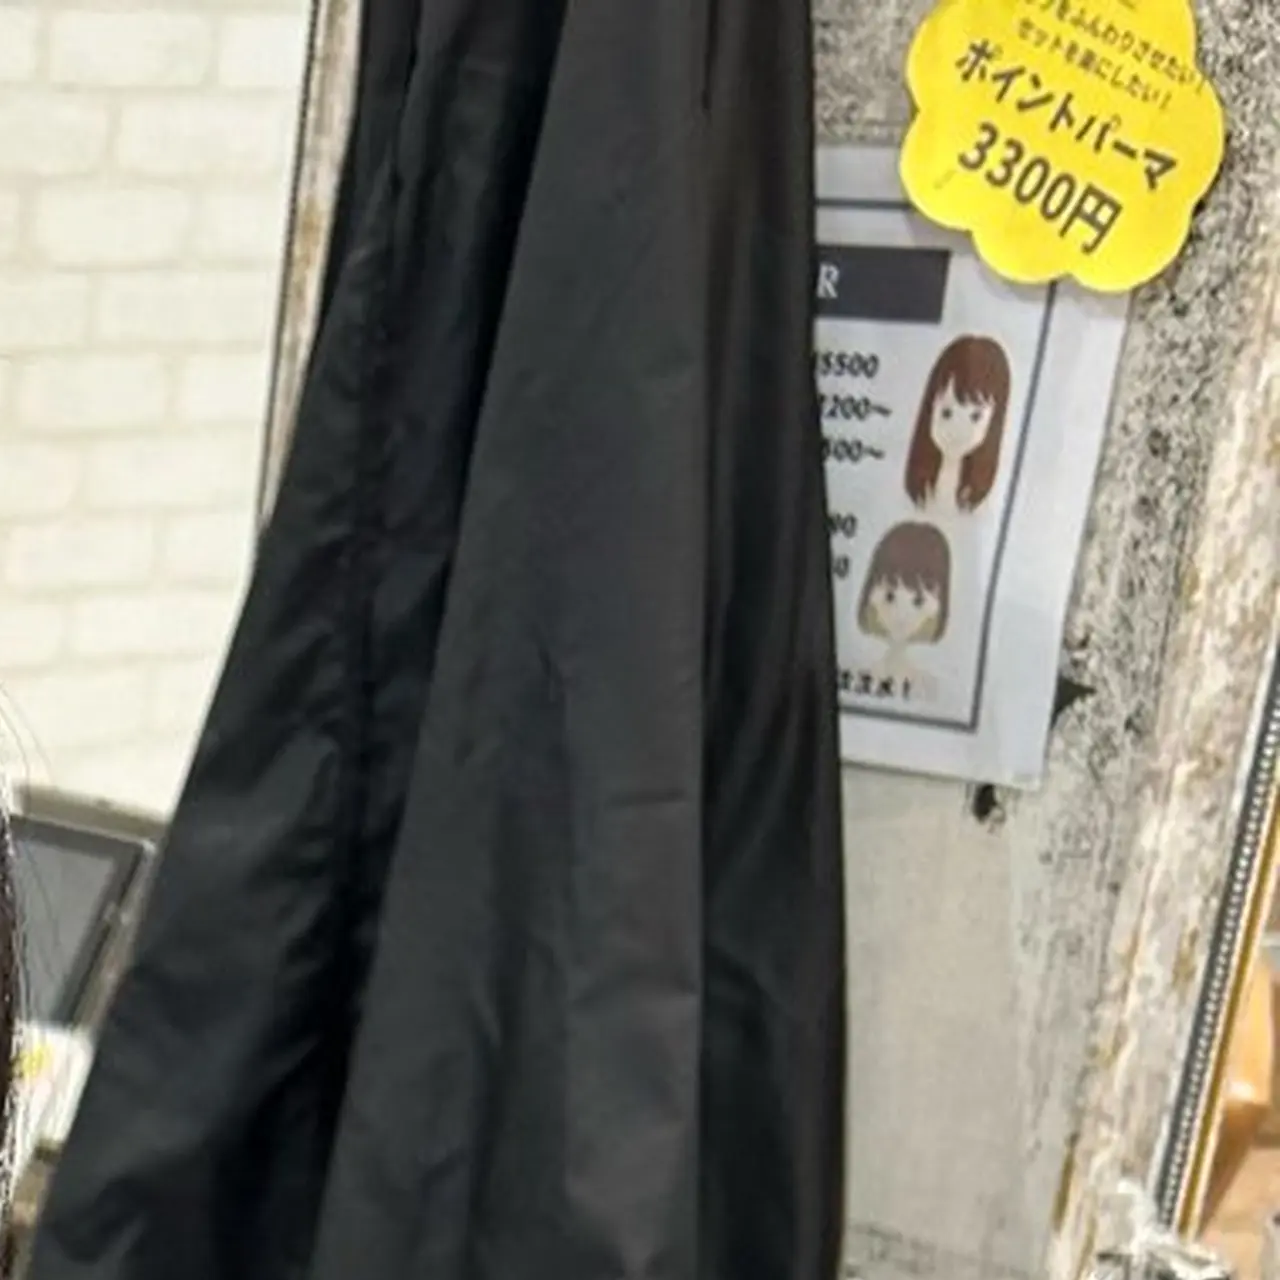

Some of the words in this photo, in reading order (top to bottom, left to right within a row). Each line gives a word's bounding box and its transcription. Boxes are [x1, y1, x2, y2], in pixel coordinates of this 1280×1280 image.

[955, 38, 1178, 191] ポイントパーマ
[957, 121, 1124, 255] 3300円
